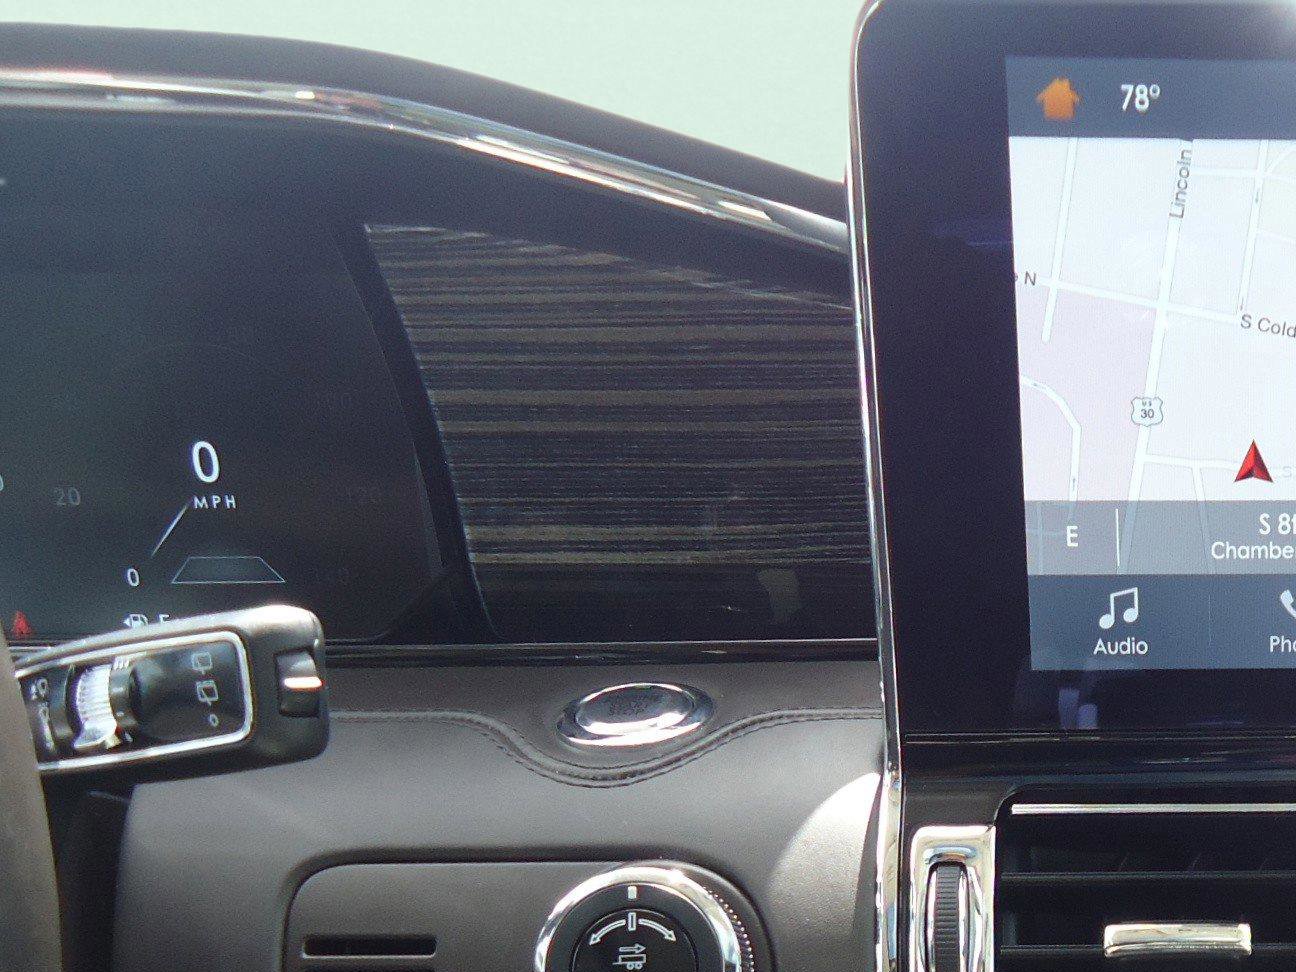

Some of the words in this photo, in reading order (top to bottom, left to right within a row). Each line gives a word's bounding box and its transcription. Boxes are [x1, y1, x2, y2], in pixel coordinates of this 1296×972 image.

[1168, 148, 1192, 220] Lincoln
[1024, 270, 1037, 286] N
[1240, 314, 1252, 329] S
[1140, 408, 1155, 419] 30
[191, 441, 220, 484] 0
[54, 487, 81, 506] 20
[193, 494, 237, 510] MPH
[1259, 513, 1272, 536] S
[1066, 525, 1079, 547] E
[126, 567, 140, 587] 0
[1093, 636, 1149, 656] Audio
